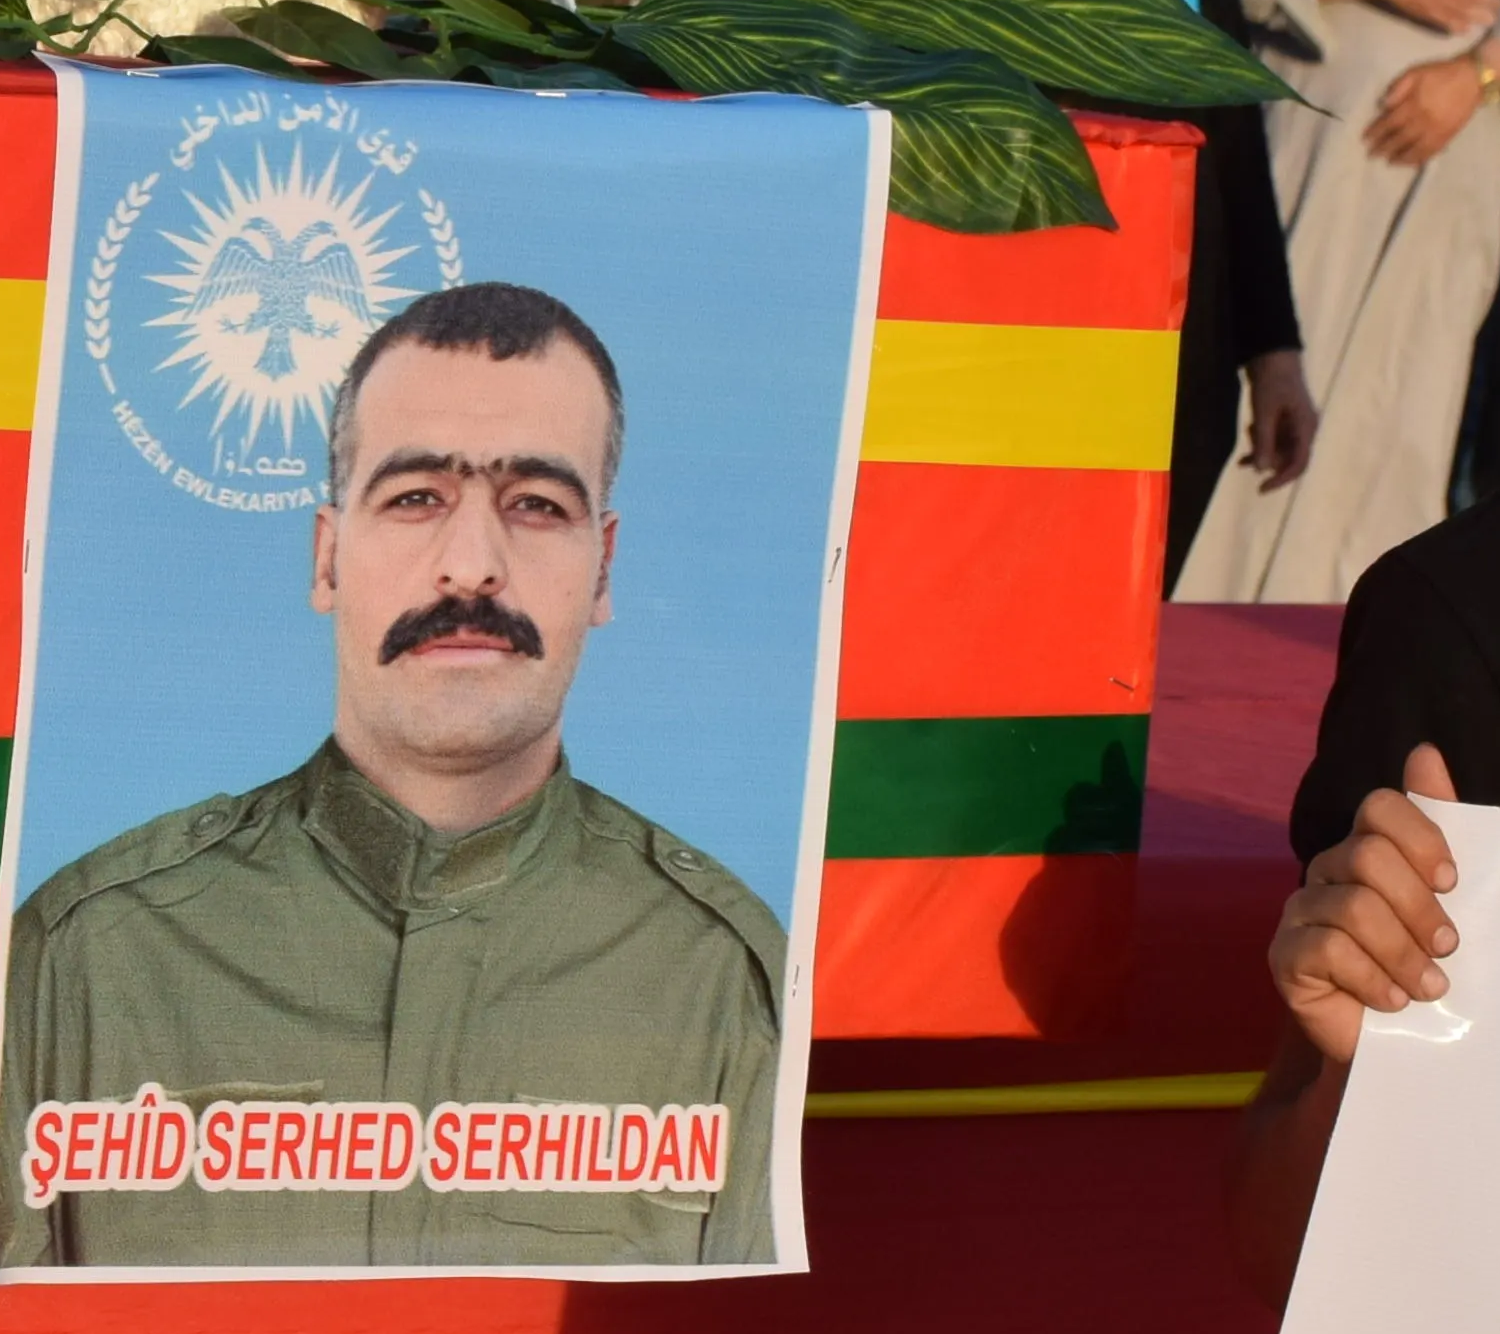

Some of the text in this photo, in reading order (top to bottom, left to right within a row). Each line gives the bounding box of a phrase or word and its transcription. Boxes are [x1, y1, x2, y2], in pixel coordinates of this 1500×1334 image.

[30, 1093, 721, 1198] ŞEHÎD SERHED SERHILDAN
